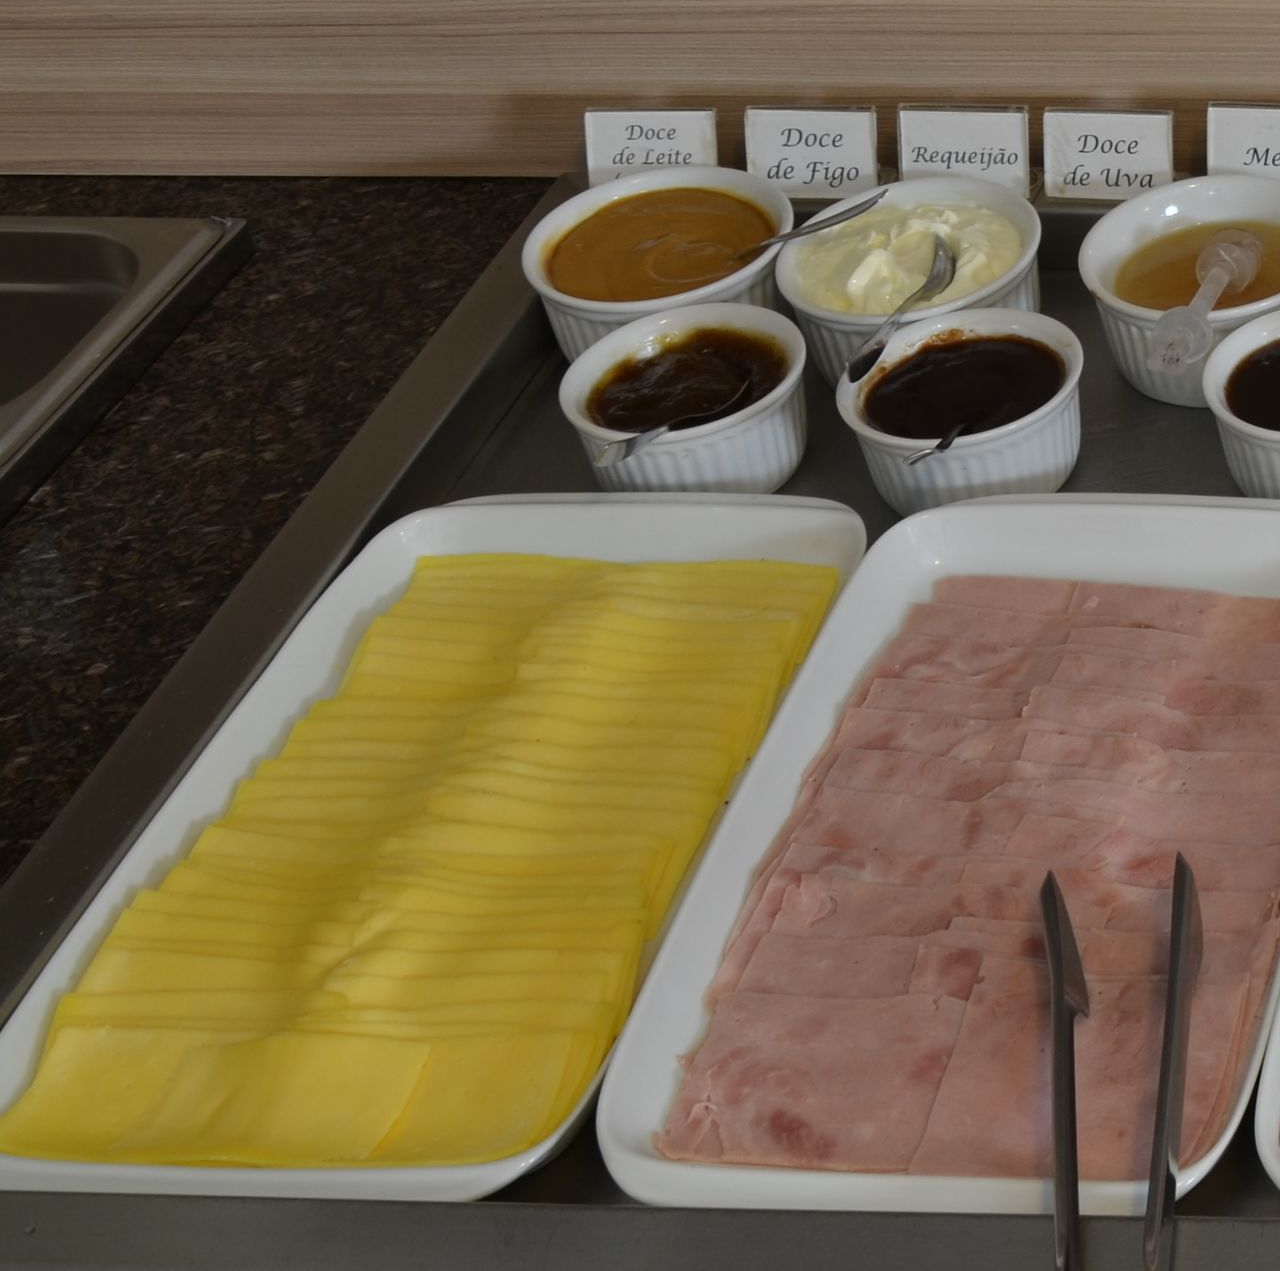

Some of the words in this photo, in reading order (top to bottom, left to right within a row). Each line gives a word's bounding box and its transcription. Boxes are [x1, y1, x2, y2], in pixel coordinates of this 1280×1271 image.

[625, 124, 677, 141] Doce
[780, 128, 844, 149] Doce
[612, 146, 636, 165] de
[641, 148, 693, 165] Leite
[1077, 134, 1139, 156] Doce
[911, 145, 1019, 170] Requeijão
[766, 158, 795, 180] de
[801, 159, 860, 187] Figo
[1062, 165, 1091, 188] de
[1099, 168, 1155, 190] Uva
